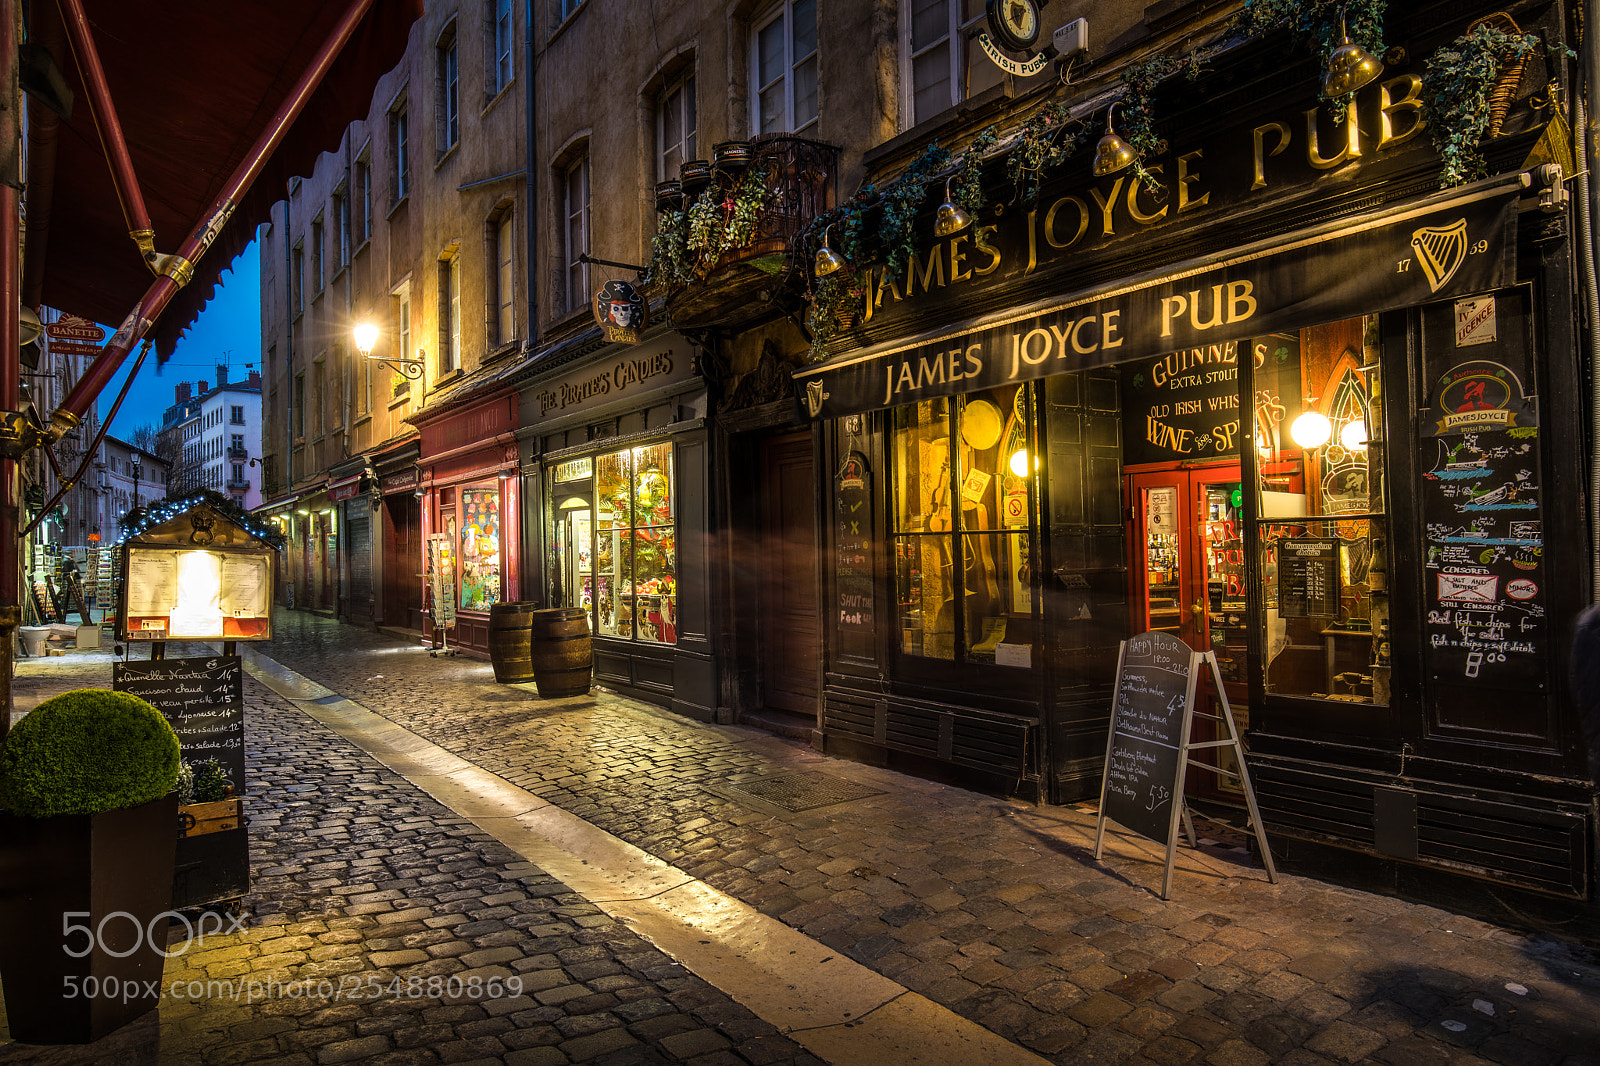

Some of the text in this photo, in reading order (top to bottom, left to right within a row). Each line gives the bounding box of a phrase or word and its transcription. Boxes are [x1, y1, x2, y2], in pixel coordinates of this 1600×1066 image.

[986, 43, 1041, 73] IRISH PUB
[864, 73, 1428, 323] JAMES JOYCE PUB
[1469, 239, 1488, 255] 59
[1396, 259, 1411, 273] 17
[1458, 304, 1493, 341] LICENCE
[53, 327, 100, 337] BANETTE
[883, 279, 1258, 405] JAMES JOYCE PUB
[1152, 341, 1267, 387] GUINNES
[1170, 368, 1238, 390] EXTRA STOUT
[1151, 404, 1170, 418] OLD
[1175, 400, 1202, 415] IRISH
[1146, 415, 1194, 453] WINE
[1195, 433, 1213, 451] AND
[1461, 425, 1478, 433] IRISH
[1443, 566, 1490, 574] CENSORED
[1509, 585, 1535, 593] MINORS
[841, 593, 861, 608] SHUT
[1463, 602, 1505, 611] CENSORED
[1453, 612, 1472, 629] fish
[1485, 614, 1511, 630] chips
[1518, 617, 1537, 633] for
[1129, 634, 1180, 657] HAPPY HOUR
[1431, 634, 1448, 649] fish
[1460, 636, 1482, 651] chips
[1510, 641, 1536, 653] drink
[175, 683, 203, 694] chaud
